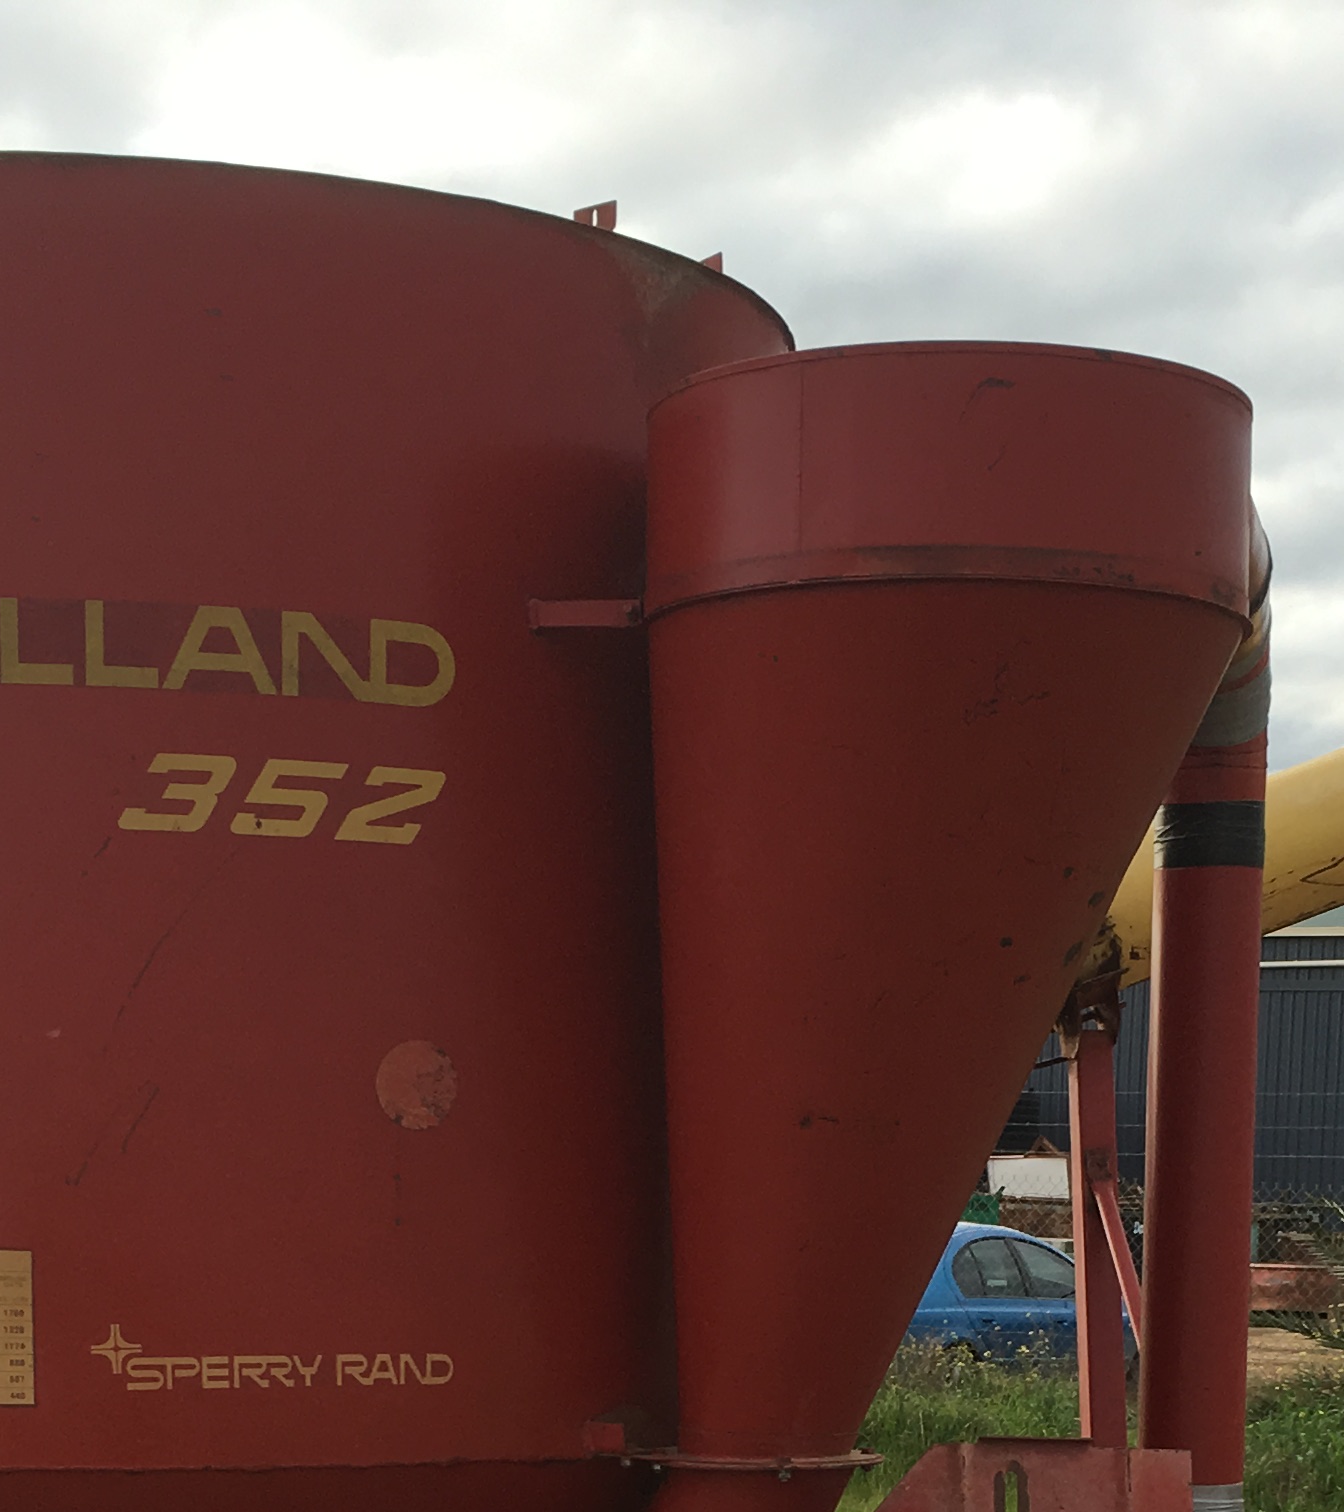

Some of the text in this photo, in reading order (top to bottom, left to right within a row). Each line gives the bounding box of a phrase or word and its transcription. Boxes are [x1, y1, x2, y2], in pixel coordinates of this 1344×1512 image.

[117, 753, 446, 844] 352
[126, 1353, 454, 1391] SPERRY RAND
